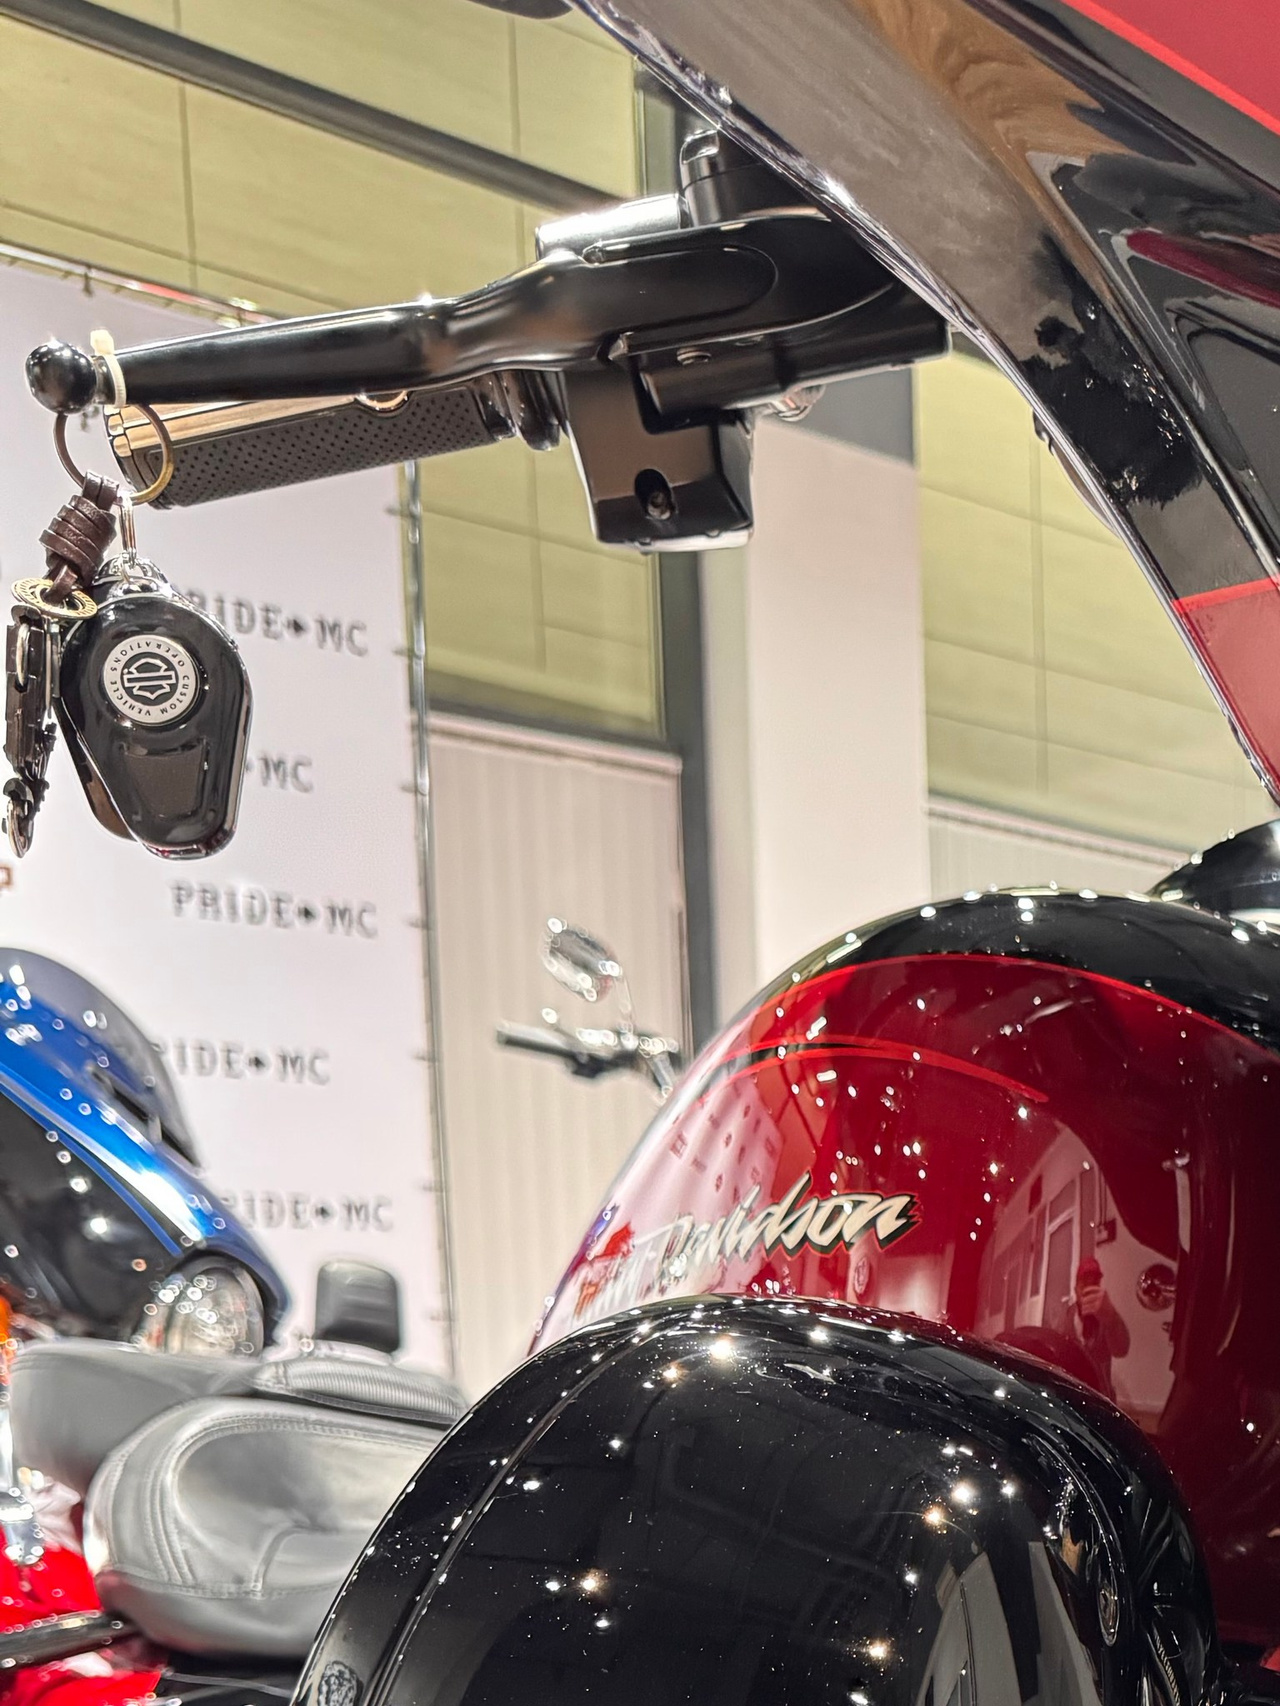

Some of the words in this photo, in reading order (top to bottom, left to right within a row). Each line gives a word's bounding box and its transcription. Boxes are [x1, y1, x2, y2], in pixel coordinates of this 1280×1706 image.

[110, 641, 185, 672] OPERATIONS
[110, 681, 151, 716] VEHICLE
[160, 675, 190, 715] CUSTOM
